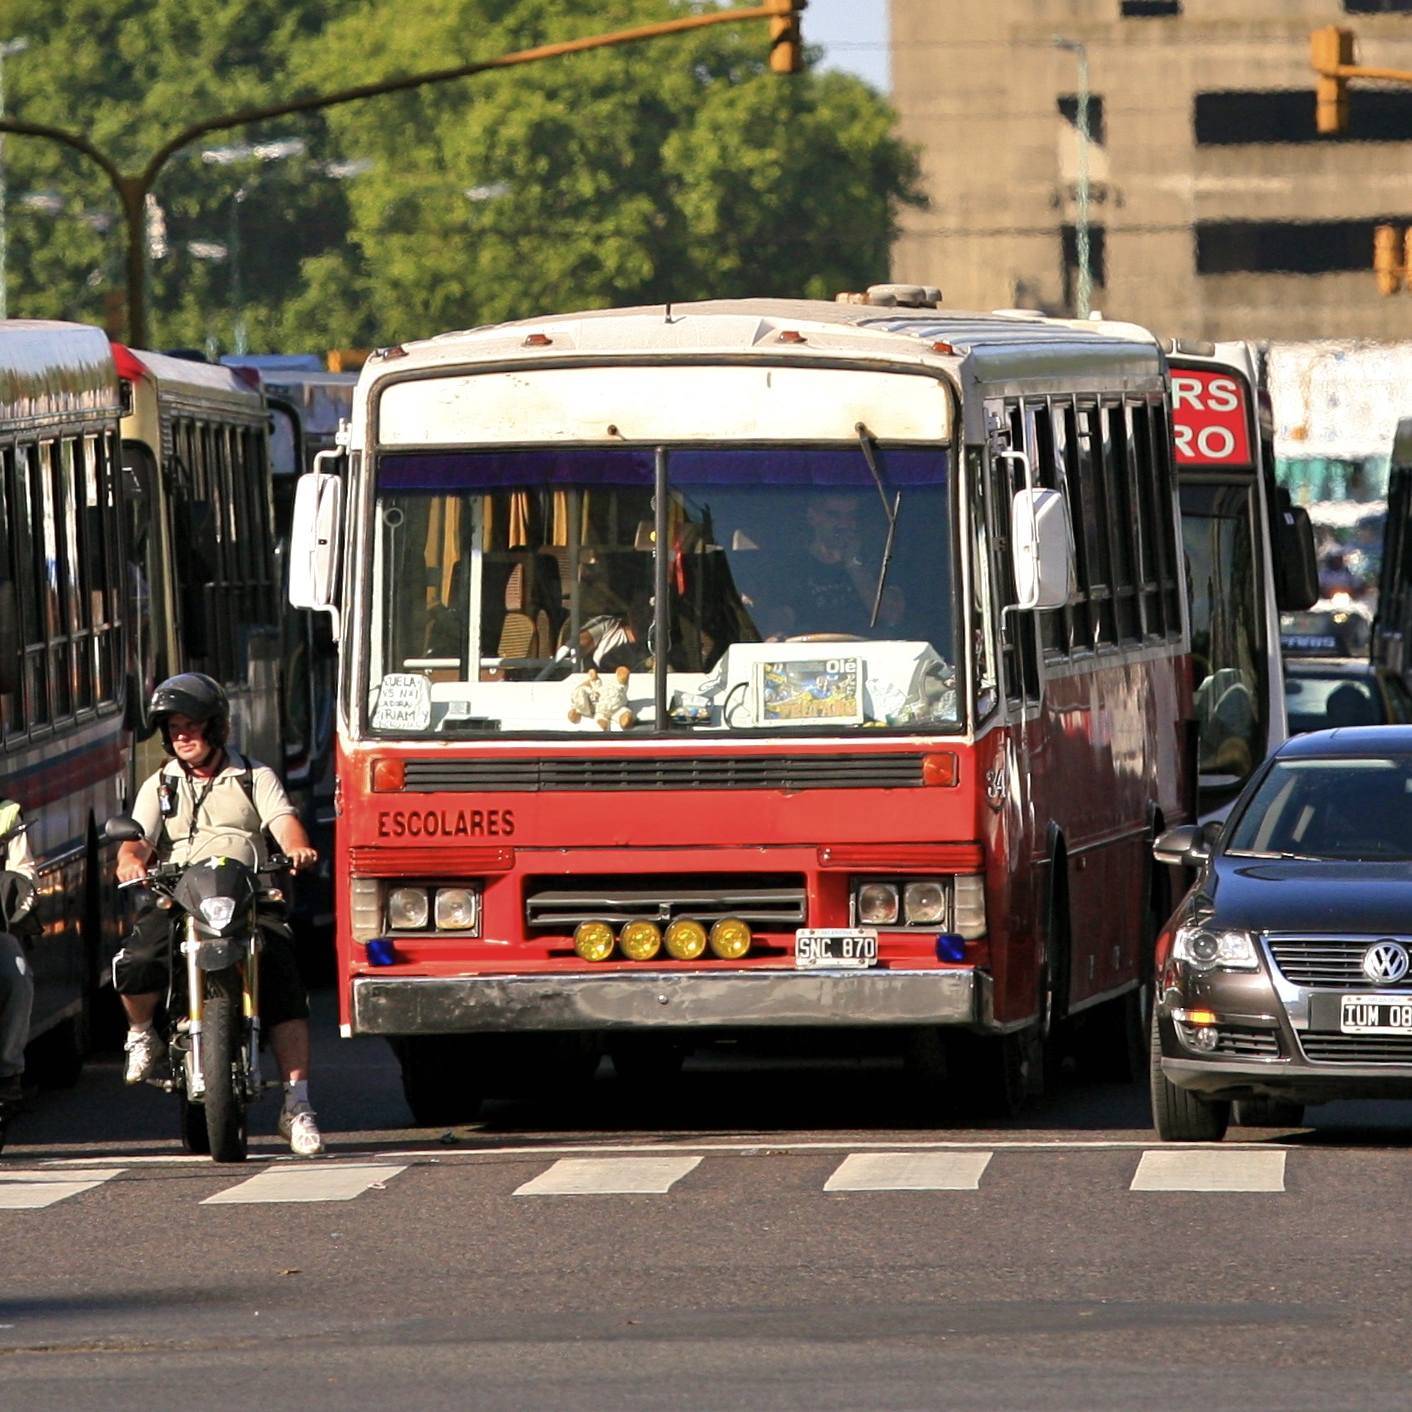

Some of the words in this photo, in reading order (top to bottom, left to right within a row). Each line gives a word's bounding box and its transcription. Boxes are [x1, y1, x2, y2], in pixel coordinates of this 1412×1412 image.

[825, 658, 857, 673] Olé
[378, 809, 515, 837] ESCOLARES
[799, 938, 832, 958] SNC
[842, 938, 875, 957] 870
[1345, 1005, 1379, 1026] IUM
